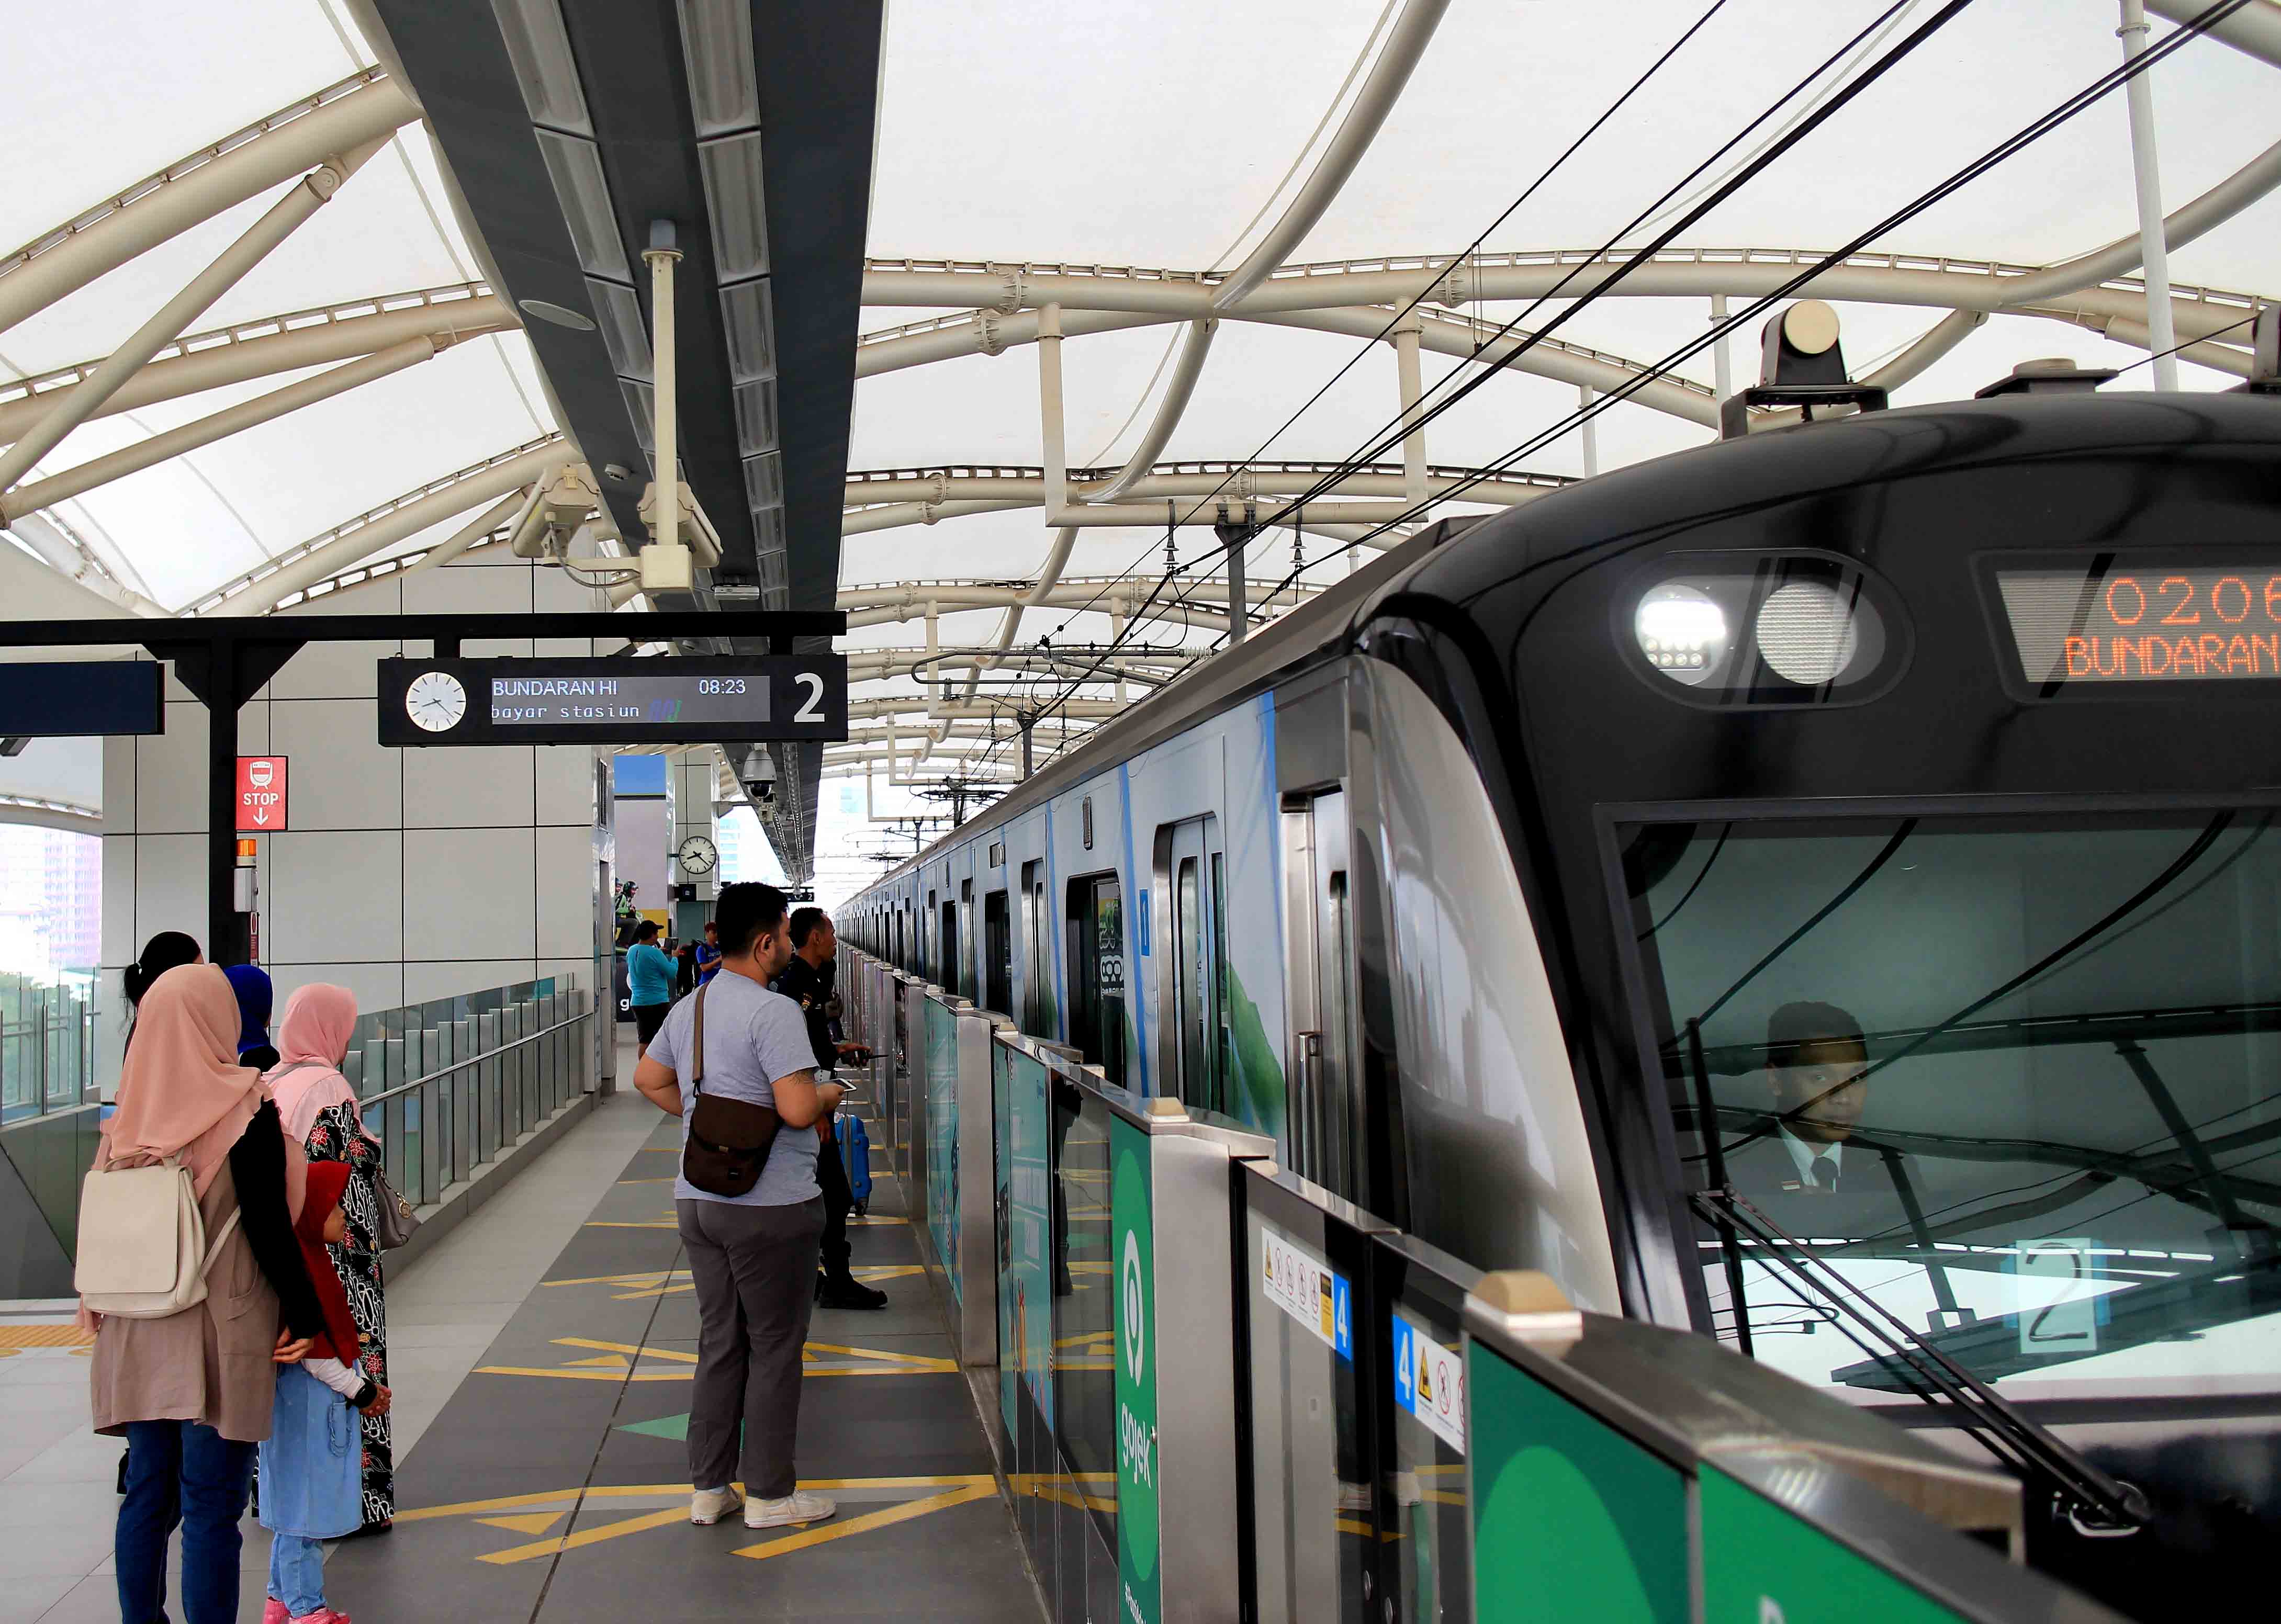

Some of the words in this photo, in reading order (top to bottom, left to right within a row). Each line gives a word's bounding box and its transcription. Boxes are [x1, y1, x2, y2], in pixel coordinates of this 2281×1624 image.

[2065, 633, 2280, 676] BUNDARAN
[493, 680, 594, 696] BUNDARAN
[599, 680, 617, 695] HI
[699, 679, 746, 694] 08:23
[793, 672, 825, 723] 2
[491, 704, 547, 721] bayar
[560, 704, 639, 718] stasiun
[243, 792, 279, 806] STOP
[2025, 1242, 2089, 1343] 2
[1338, 1286, 1348, 1348] 4
[1399, 1331, 1411, 1401] 4
[1121, 1402, 1151, 1490] gojek
